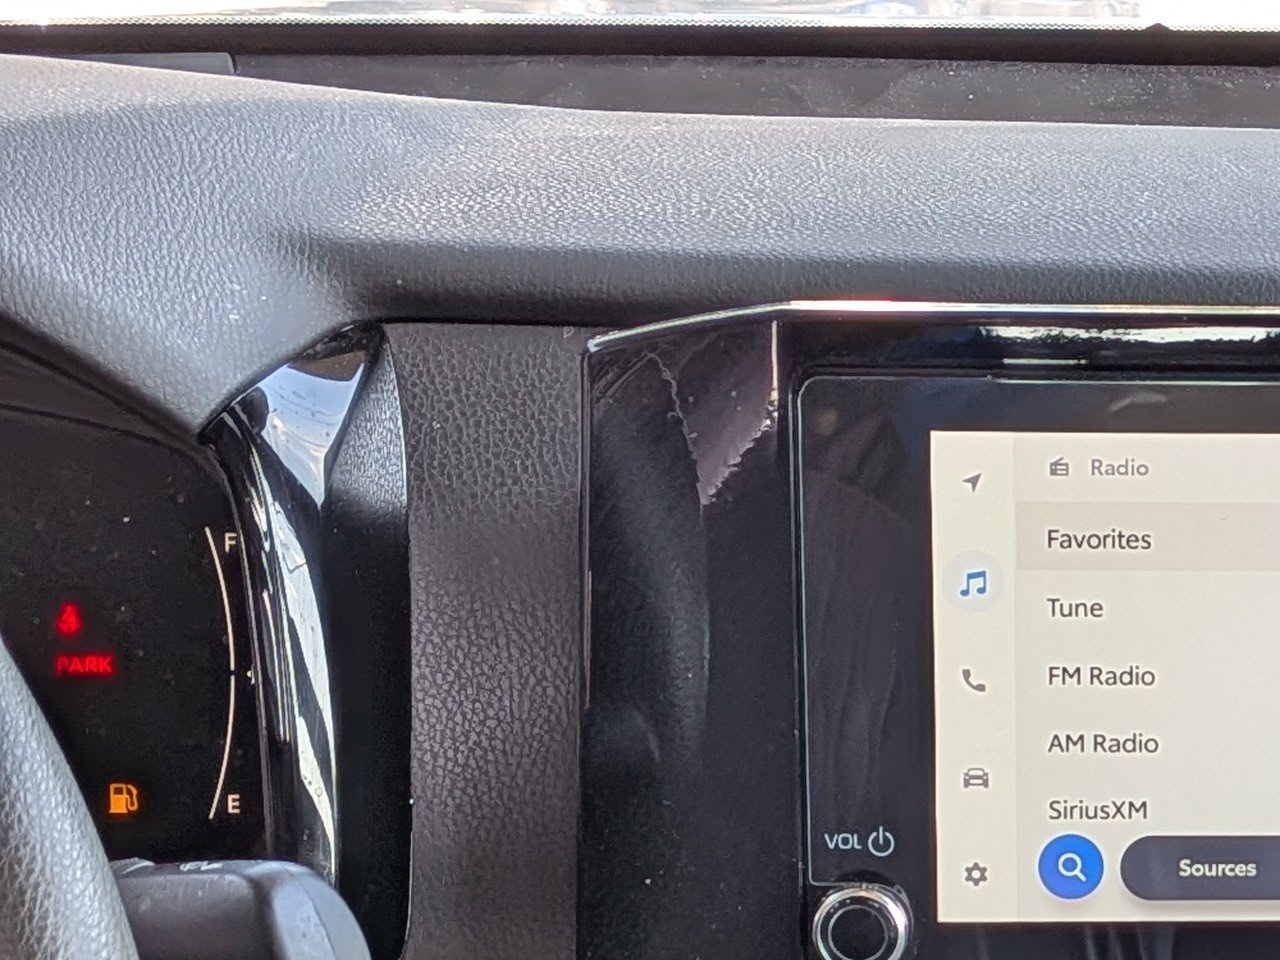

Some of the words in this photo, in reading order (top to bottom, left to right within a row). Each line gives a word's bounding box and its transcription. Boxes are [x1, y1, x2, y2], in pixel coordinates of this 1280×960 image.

[1090, 459, 1149, 477] Radio
[225, 533, 237, 552] F
[1047, 529, 1152, 550] Favorites
[1047, 598, 1104, 618] Tune
[56, 656, 114, 674] PARK
[1048, 667, 1081, 686] FM
[1089, 666, 1156, 687] Radio
[1048, 734, 1085, 753] AM
[1093, 733, 1160, 754] Radio
[227, 795, 240, 814] E
[1048, 801, 1149, 820] SiriusXM
[824, 833, 862, 849] VOL
[1178, 859, 1257, 877] Sources
